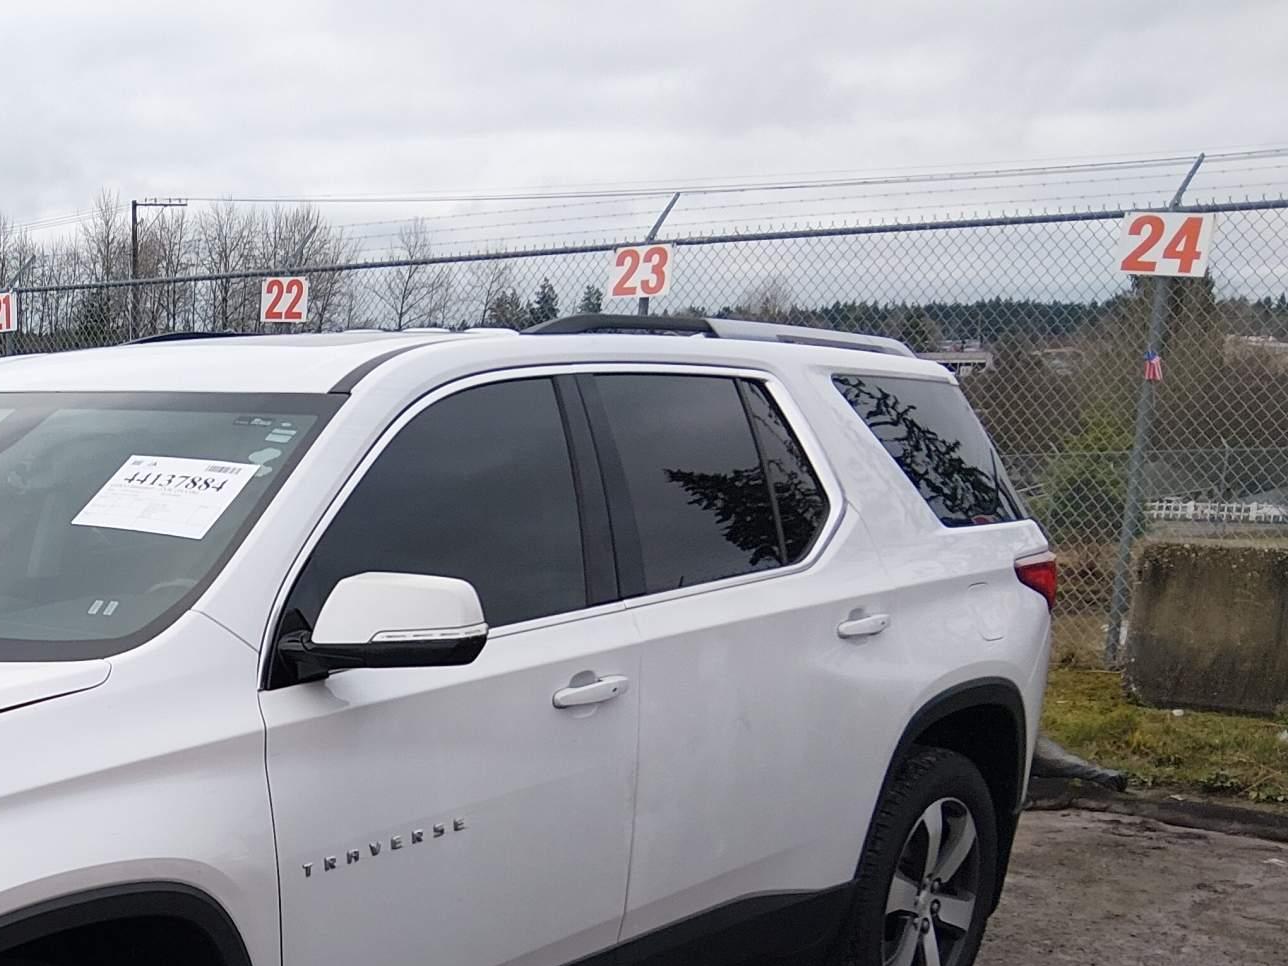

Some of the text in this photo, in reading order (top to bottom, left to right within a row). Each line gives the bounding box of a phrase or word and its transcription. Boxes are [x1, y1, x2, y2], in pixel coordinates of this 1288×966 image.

[1120, 214, 1204, 274] 24
[612, 246, 669, 297] 23
[264, 279, 304, 320] 22
[124, 471, 229, 492] 44137884
[302, 817, 467, 878] TRAVERSE
